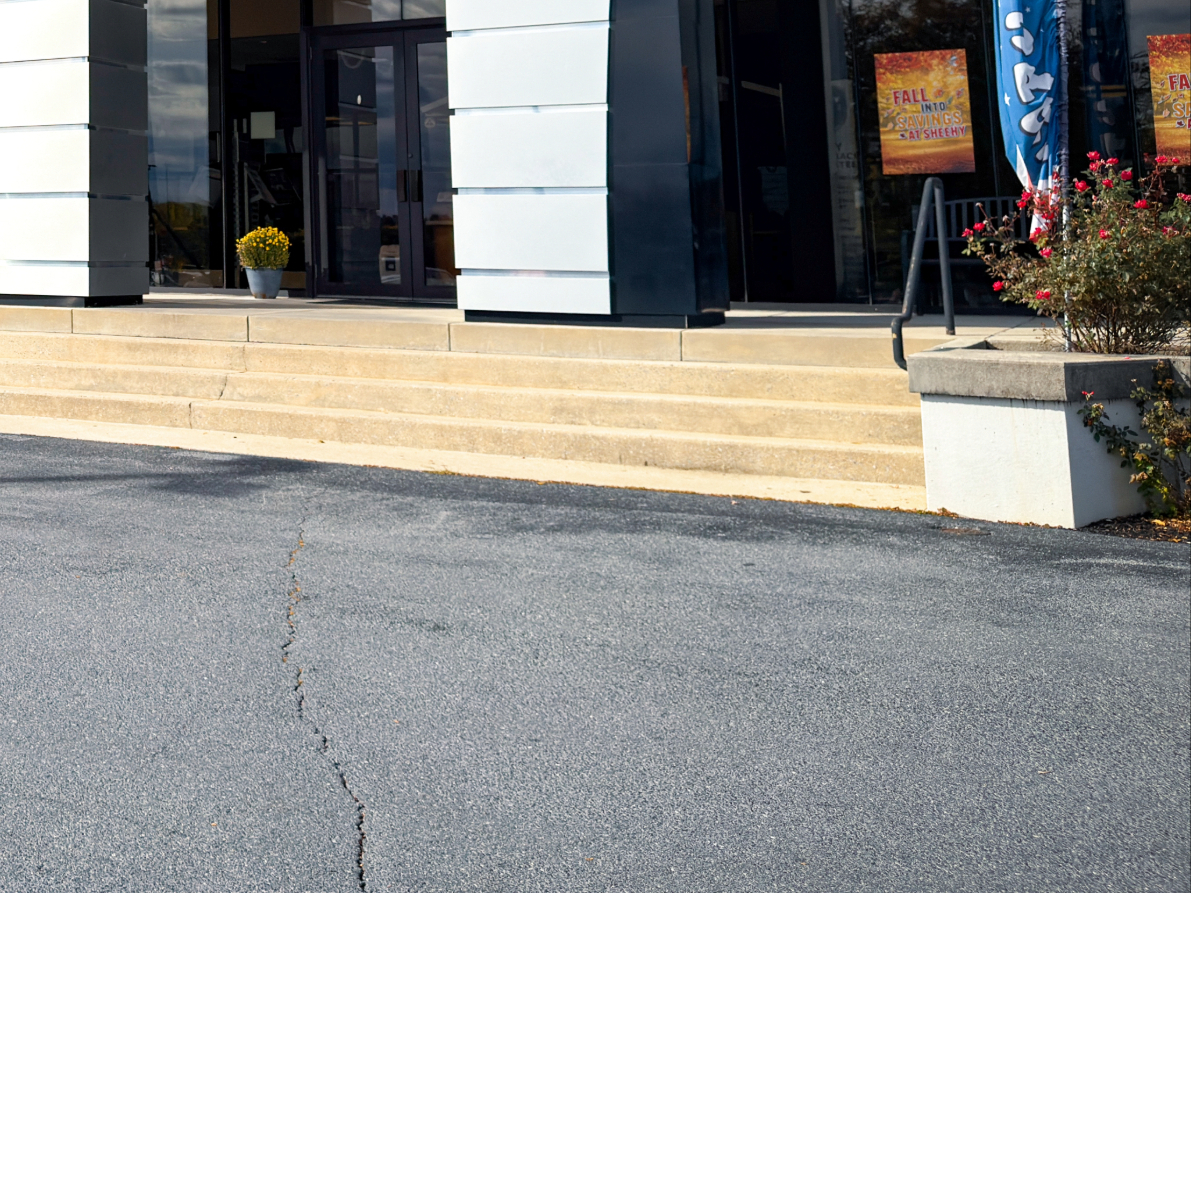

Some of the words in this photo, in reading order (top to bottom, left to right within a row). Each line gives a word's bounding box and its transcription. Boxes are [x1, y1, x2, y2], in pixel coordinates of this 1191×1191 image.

[892, 88, 929, 105] FALL
[921, 102, 946, 113] INTO
[897, 111, 962, 130] SAVINGS
[908, 130, 921, 140] AT
[923, 125, 966, 139] SHEEHY
